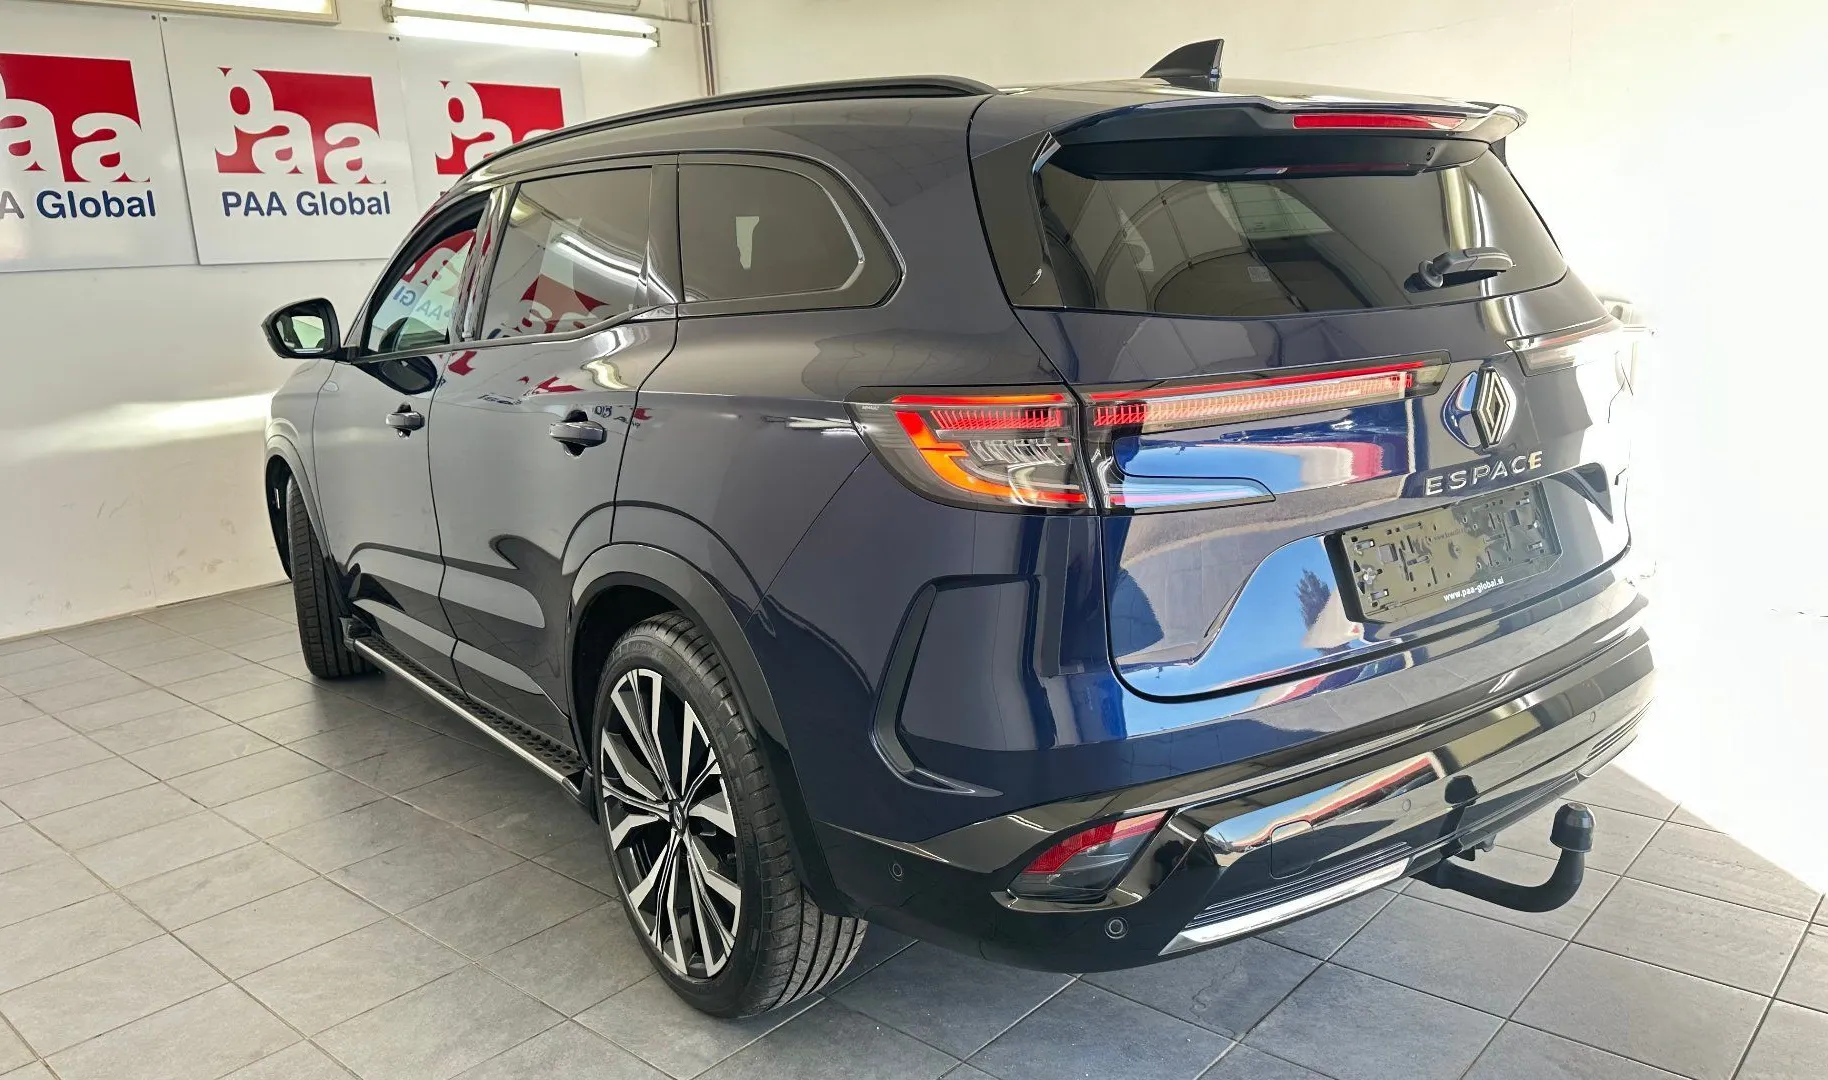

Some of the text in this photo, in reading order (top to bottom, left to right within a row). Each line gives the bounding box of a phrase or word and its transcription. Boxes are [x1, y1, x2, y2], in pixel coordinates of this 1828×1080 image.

[36, 190, 156, 218] Global
[221, 190, 390, 217] PAA Global
[1424, 450, 1543, 496] ESPACE
[1443, 576, 1505, 602] www.paa-global.si
